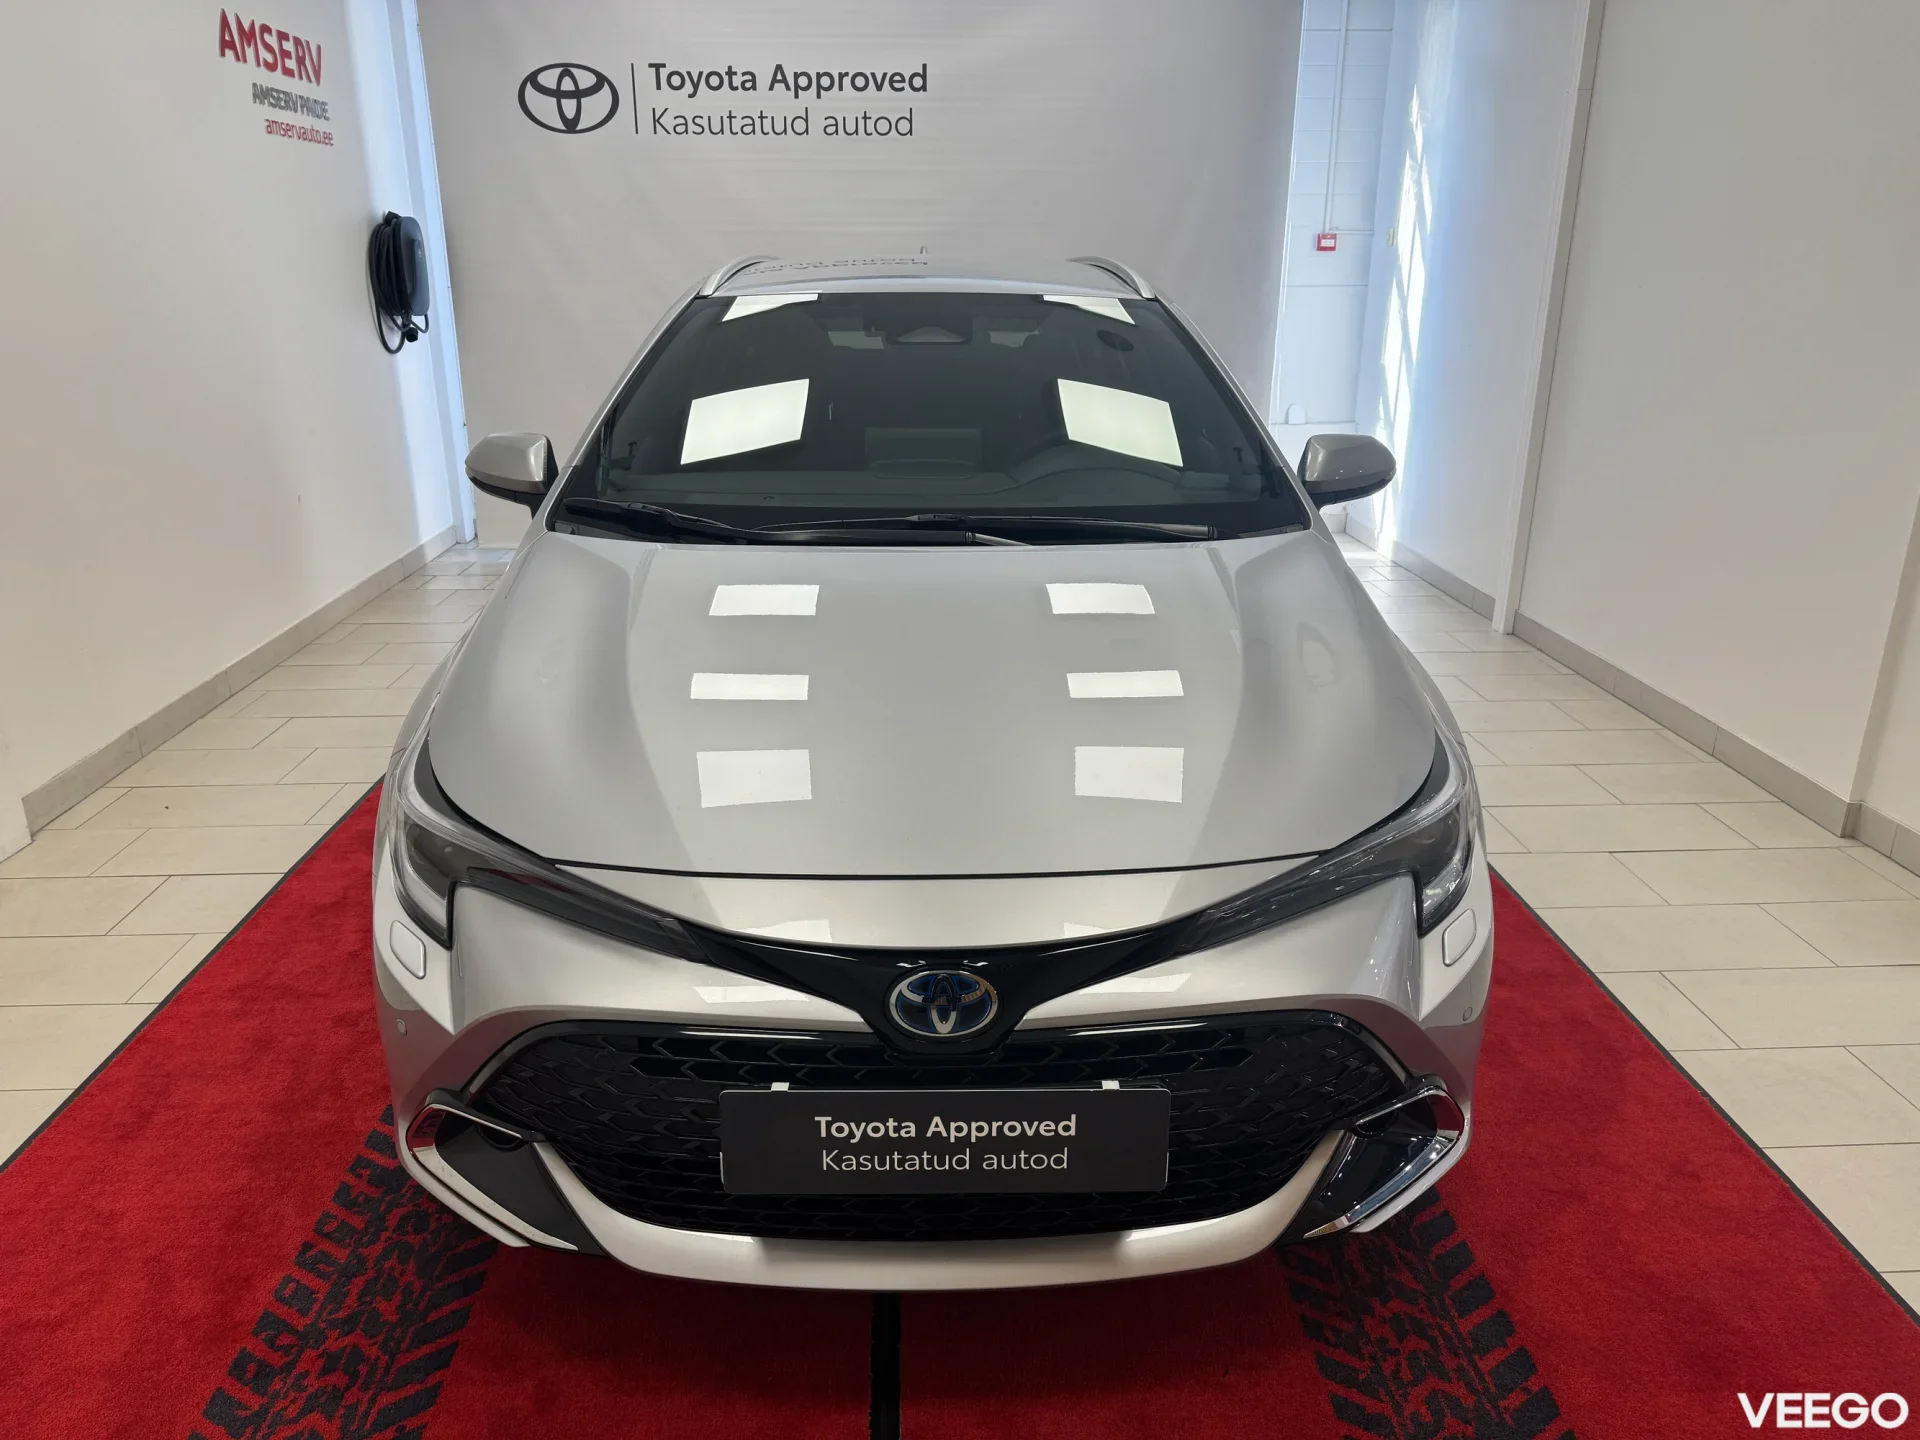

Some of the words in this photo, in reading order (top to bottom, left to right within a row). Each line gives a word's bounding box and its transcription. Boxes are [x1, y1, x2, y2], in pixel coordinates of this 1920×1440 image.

[218, 8, 322, 86] AMSERV
[648, 63, 757, 98] Toyota
[768, 63, 929, 98] Approved
[252, 82, 299, 114] AMSERV
[264, 118, 334, 147] amservauto.ee
[652, 107, 809, 136] Kasutatud
[823, 108, 913, 137] autod
[814, 1116, 916, 1143] Toyota
[926, 1114, 1077, 1143] Approved
[822, 1148, 971, 1171] Kasutatud
[982, 1147, 1069, 1170] autod
